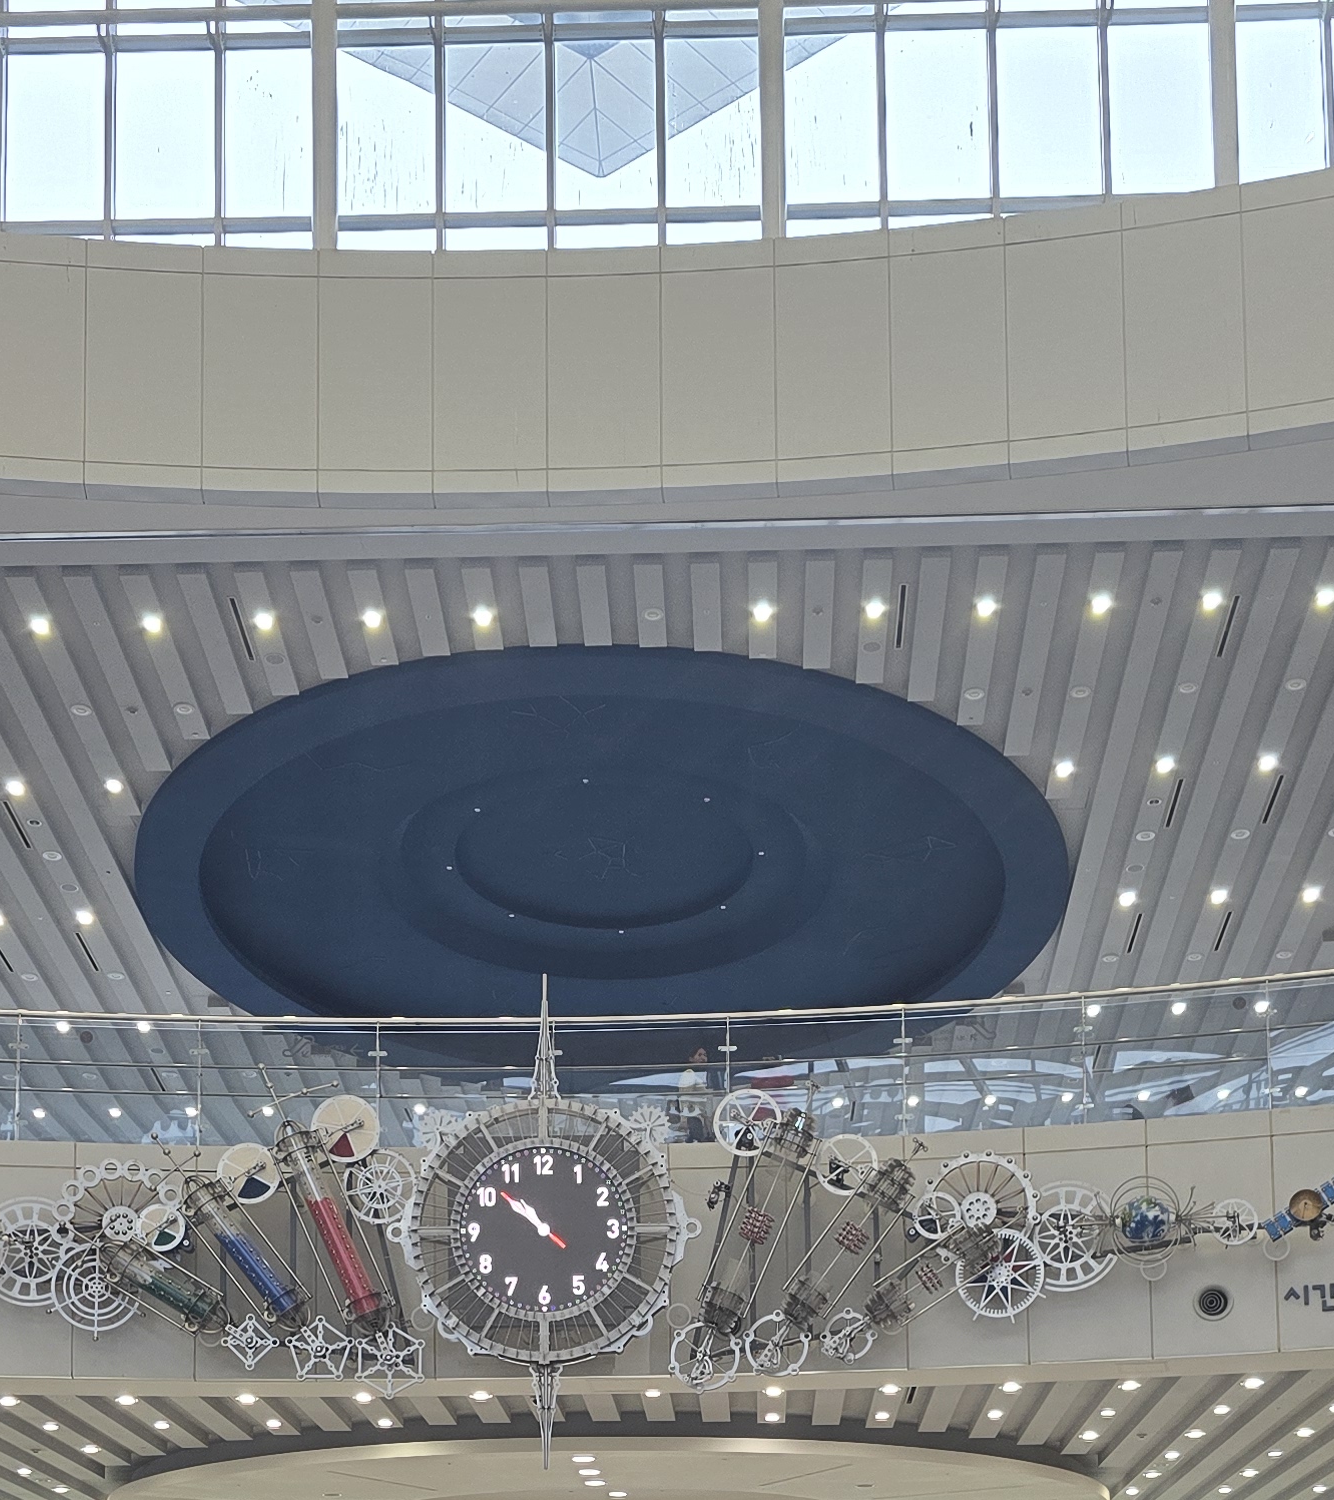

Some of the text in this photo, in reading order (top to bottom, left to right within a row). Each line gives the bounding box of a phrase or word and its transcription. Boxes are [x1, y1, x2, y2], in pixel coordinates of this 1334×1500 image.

[501, 1163, 521, 1184] 11
[533, 1154, 555, 1176] 12
[573, 1164, 584, 1184] 1
[476, 1187, 497, 1207] 10
[596, 1187, 610, 1207] 2
[467, 1223, 481, 1243] 9
[606, 1218, 620, 1240] 3
[478, 1254, 493, 1274] 8
[595, 1252, 610, 1272] 4
[504, 1276, 518, 1296] 7
[538, 1285, 551, 1305] 6
[572, 1275, 585, 1296] 5
